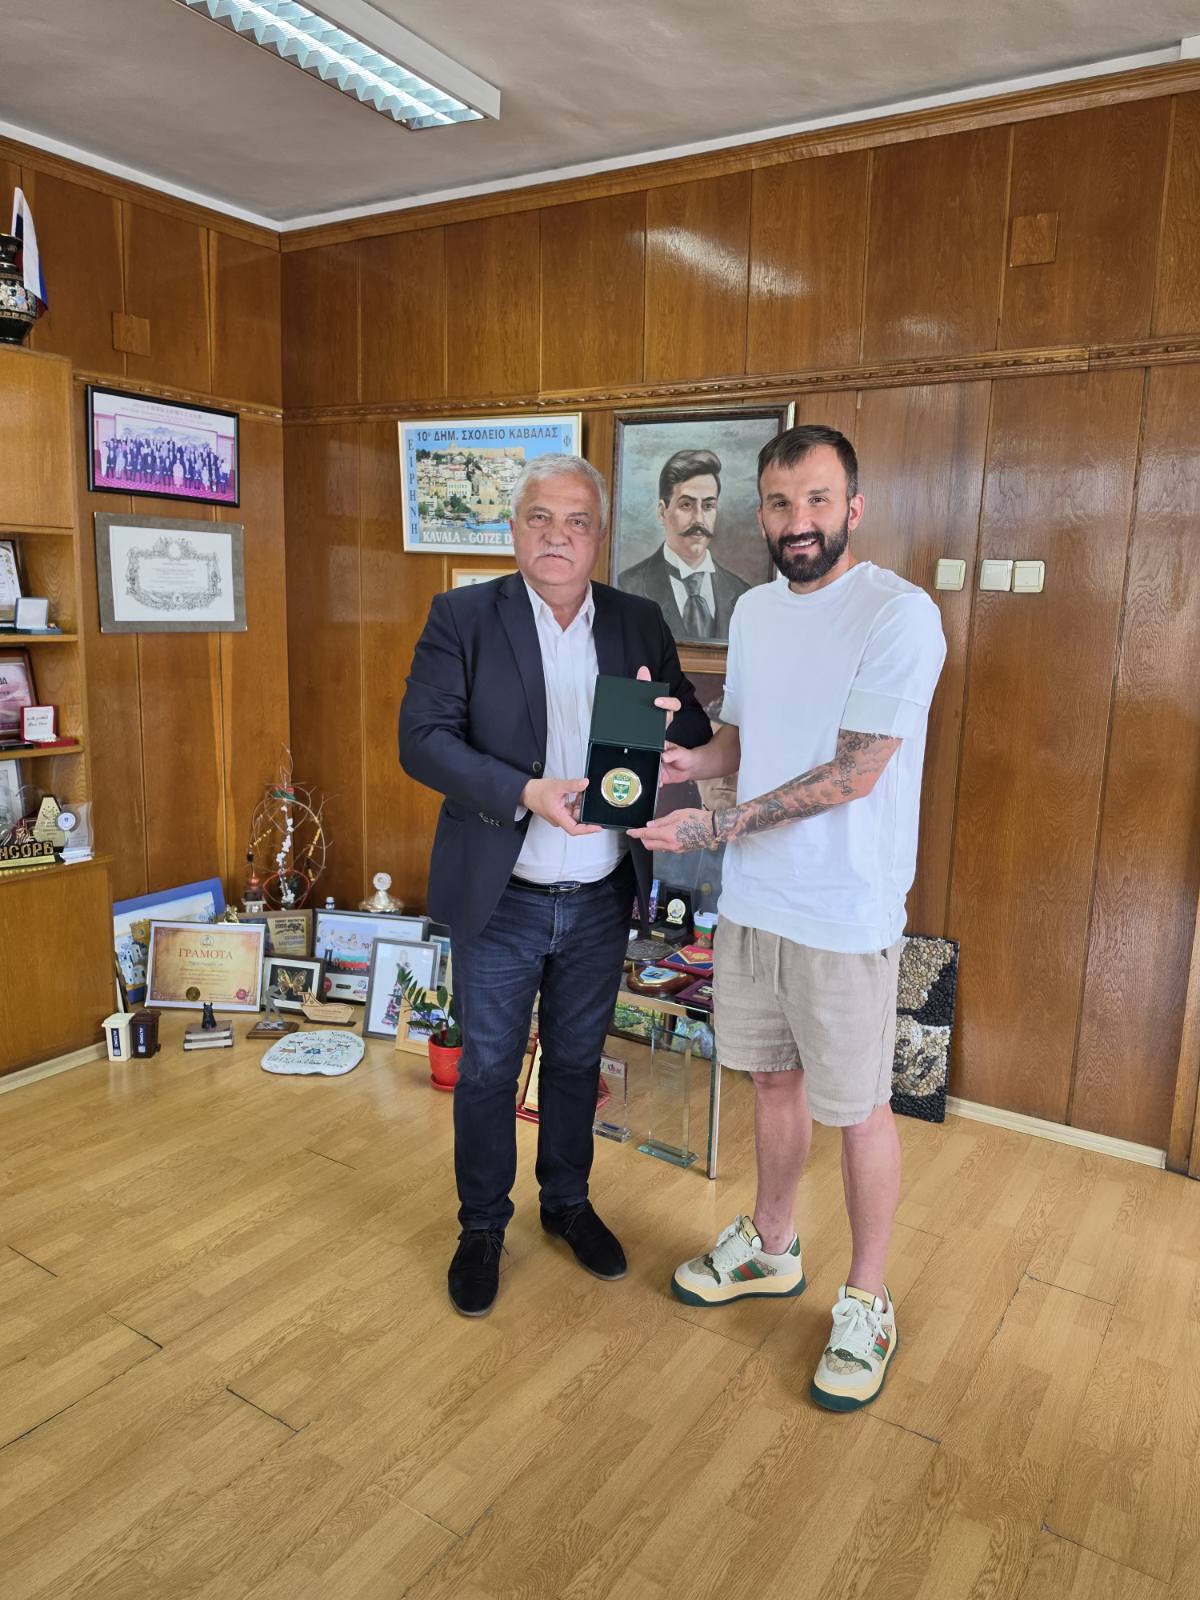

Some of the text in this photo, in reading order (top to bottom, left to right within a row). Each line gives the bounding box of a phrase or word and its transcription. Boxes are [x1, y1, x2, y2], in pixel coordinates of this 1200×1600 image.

[462, 429, 505, 441] ΣΧΟΛΕΙΟ
[509, 427, 558, 439] ΚΑΒΑΛΑΣ
[423, 531, 460, 543] KAVALA
[179, 948, 232, 960] ГРАМОТА
